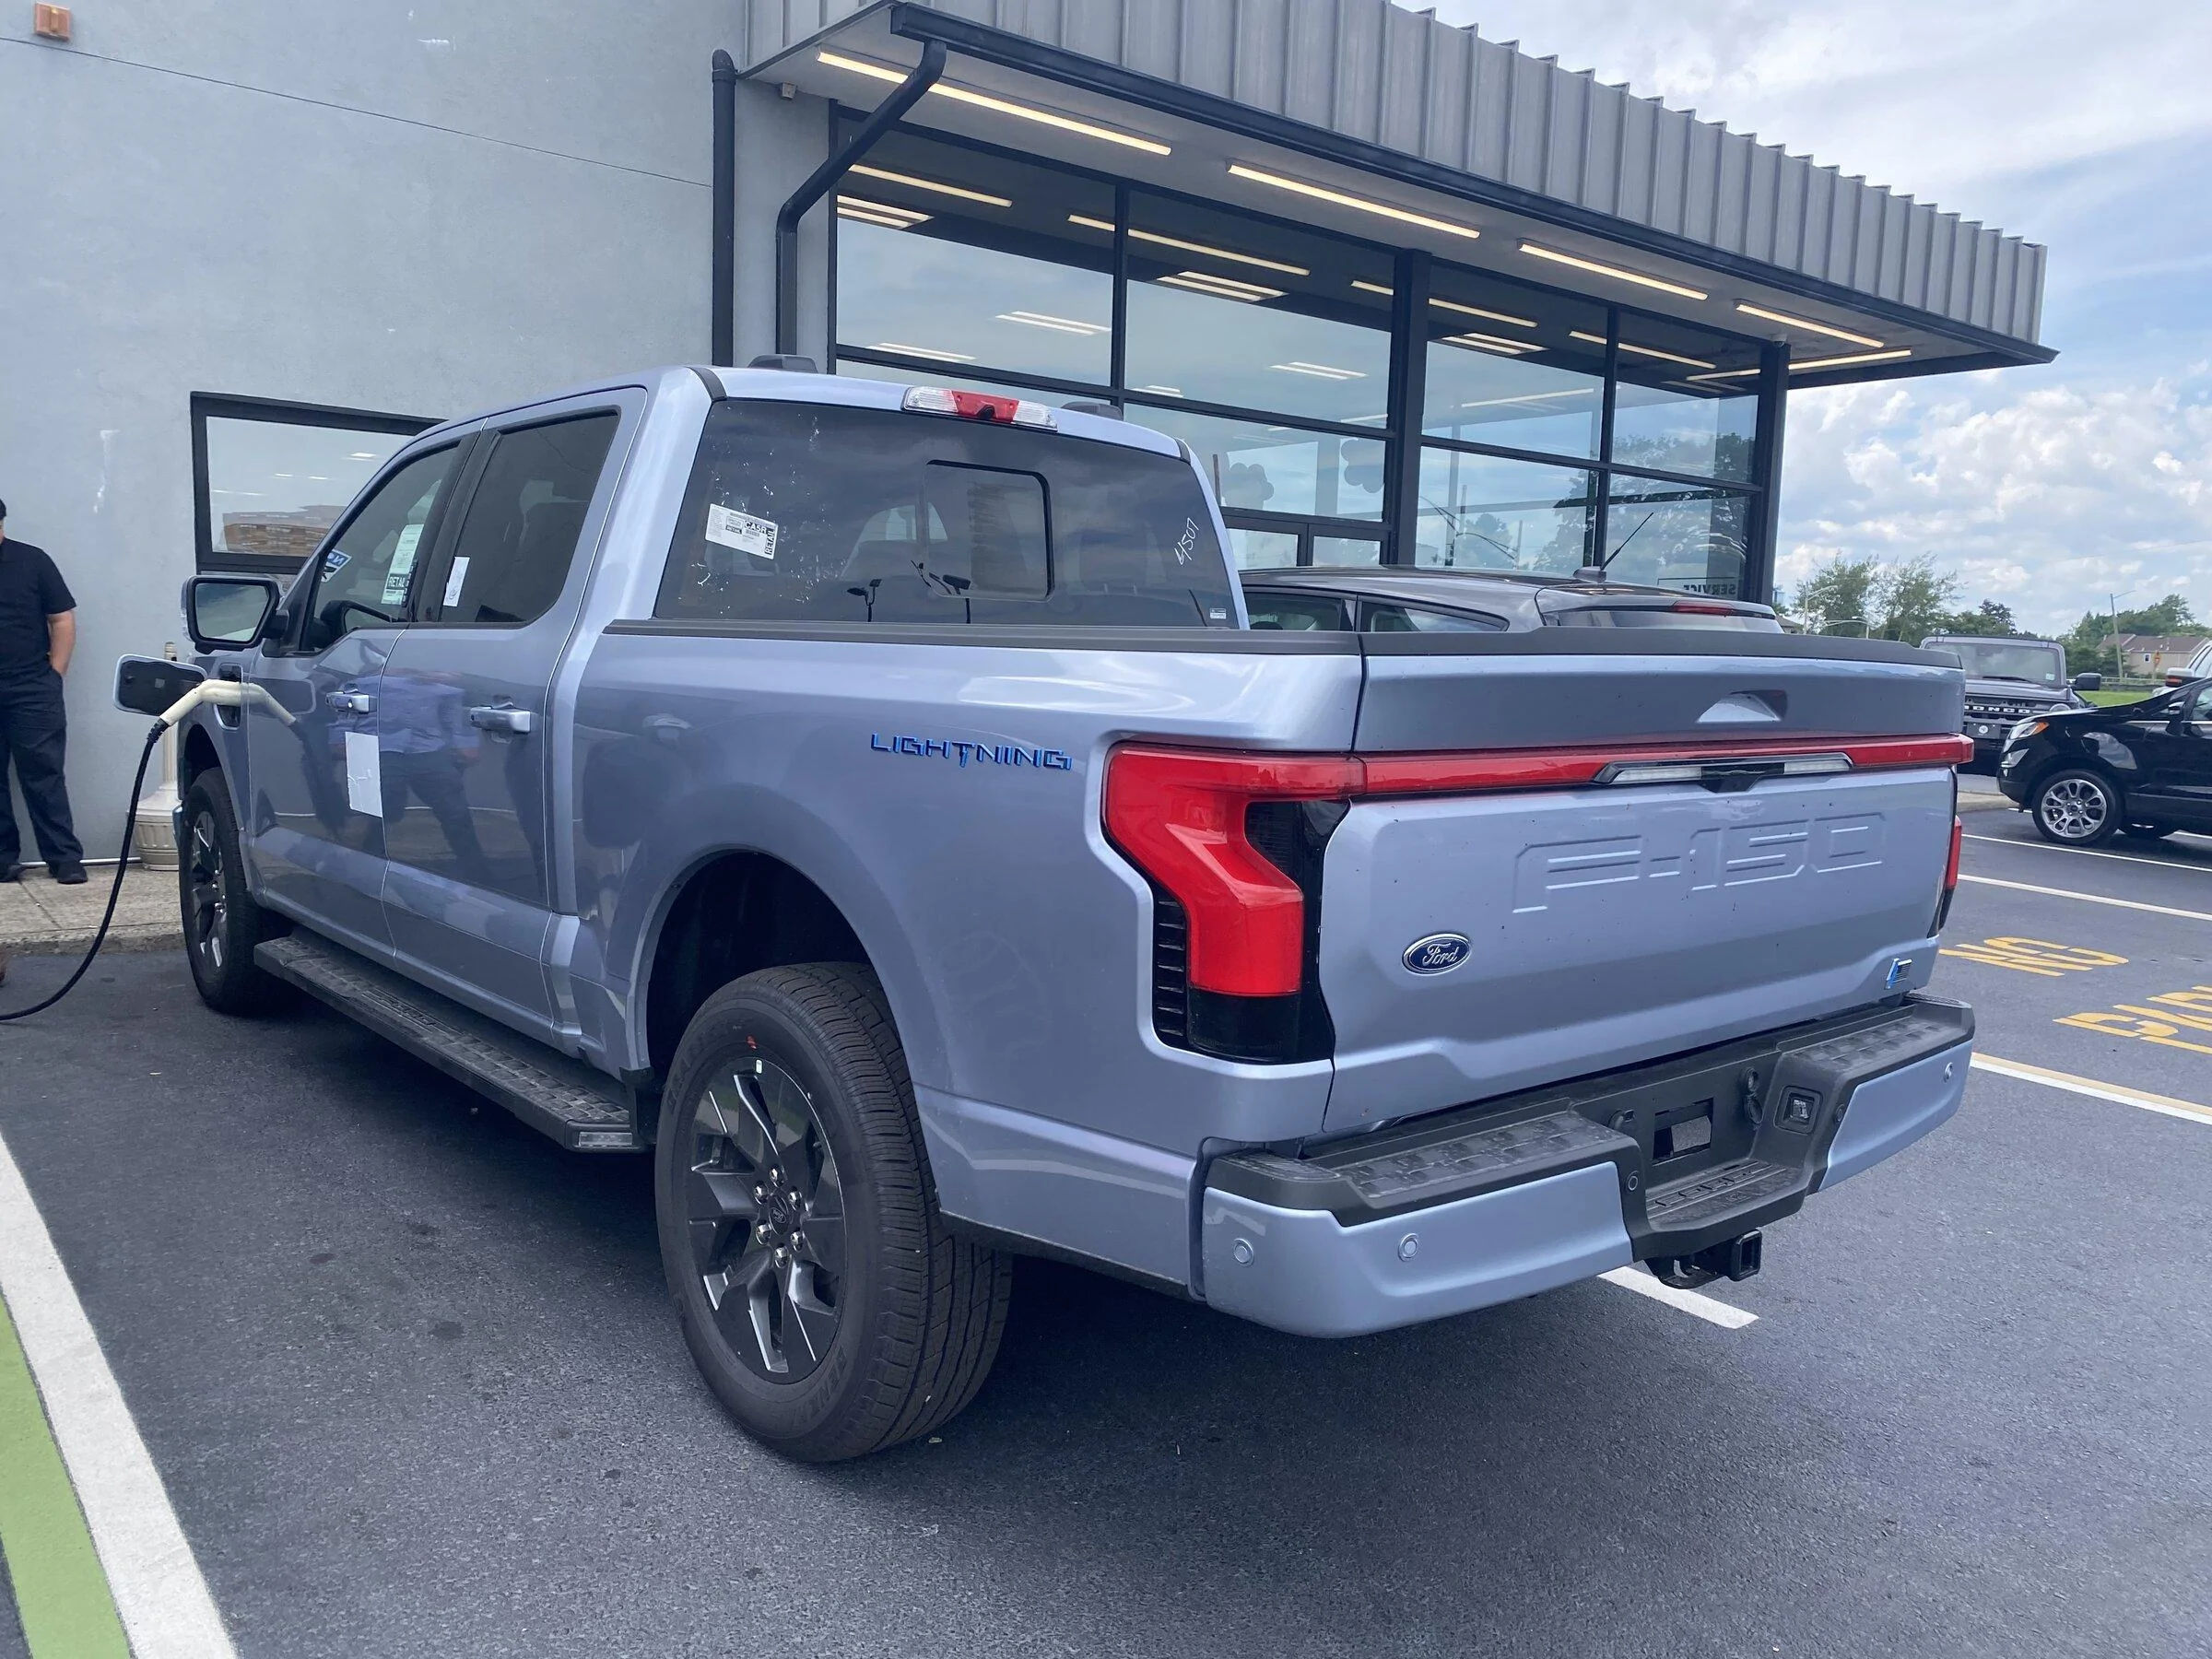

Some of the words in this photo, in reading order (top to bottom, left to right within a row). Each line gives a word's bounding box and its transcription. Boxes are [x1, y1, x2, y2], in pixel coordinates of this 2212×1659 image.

[1964, 705, 2030, 714] ONCO
[871, 733, 1072, 770] LIGHTNING
[1512, 812, 1886, 913] F-150
